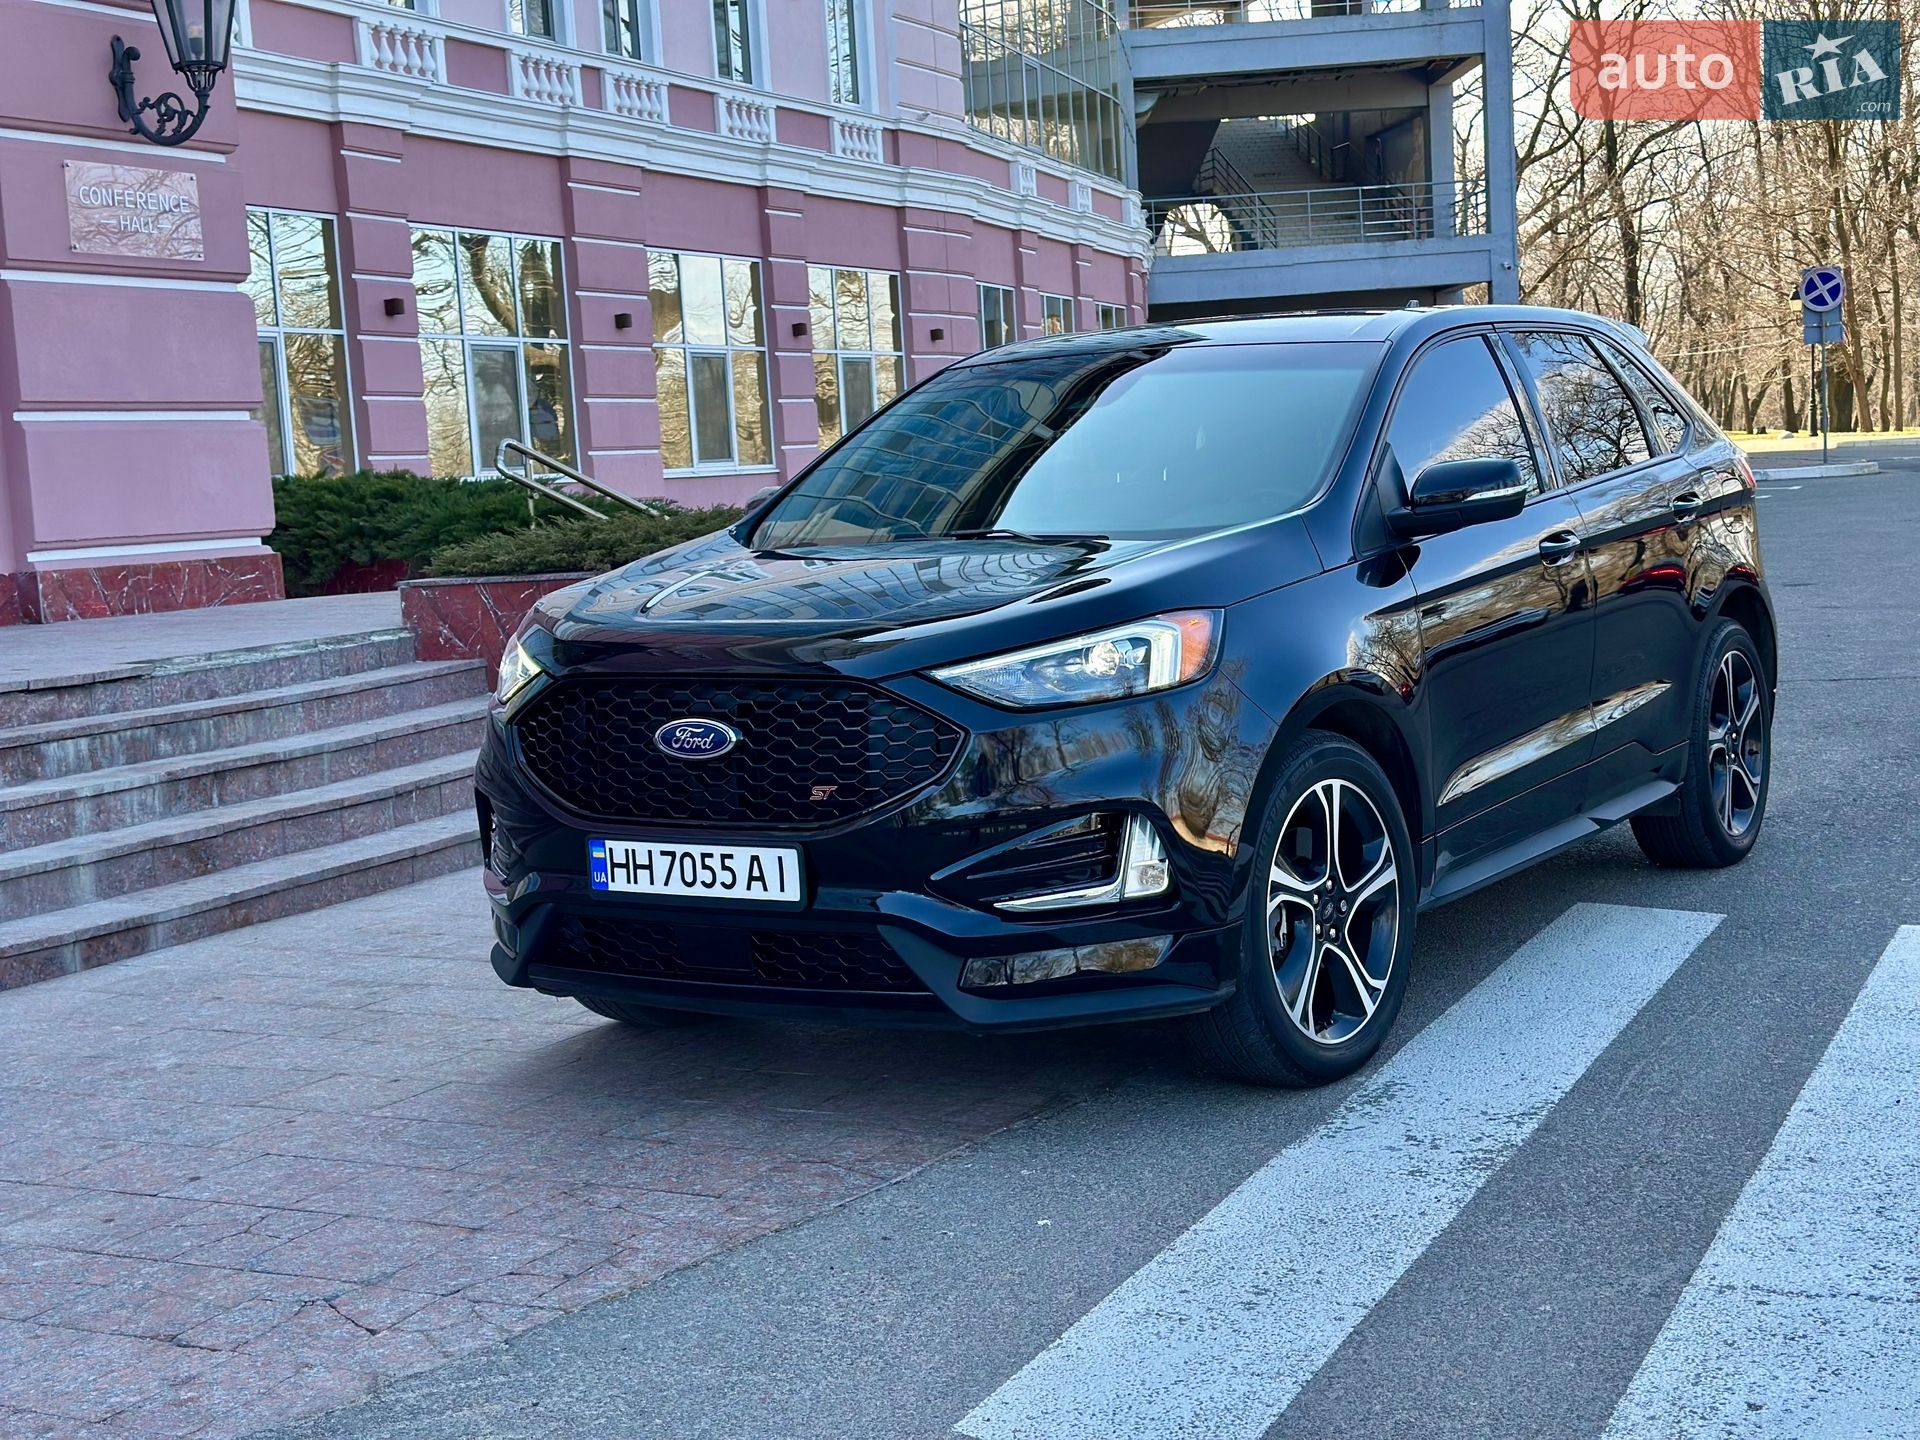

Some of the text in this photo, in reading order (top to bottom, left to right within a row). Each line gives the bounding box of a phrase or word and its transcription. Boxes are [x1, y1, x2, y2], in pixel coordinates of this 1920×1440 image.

[79, 186, 190, 213] CONFERENCE
[120, 216, 158, 234] HALL
[671, 726, 715, 749] Ford
[809, 785, 839, 801] ST
[594, 871, 607, 883] UA
